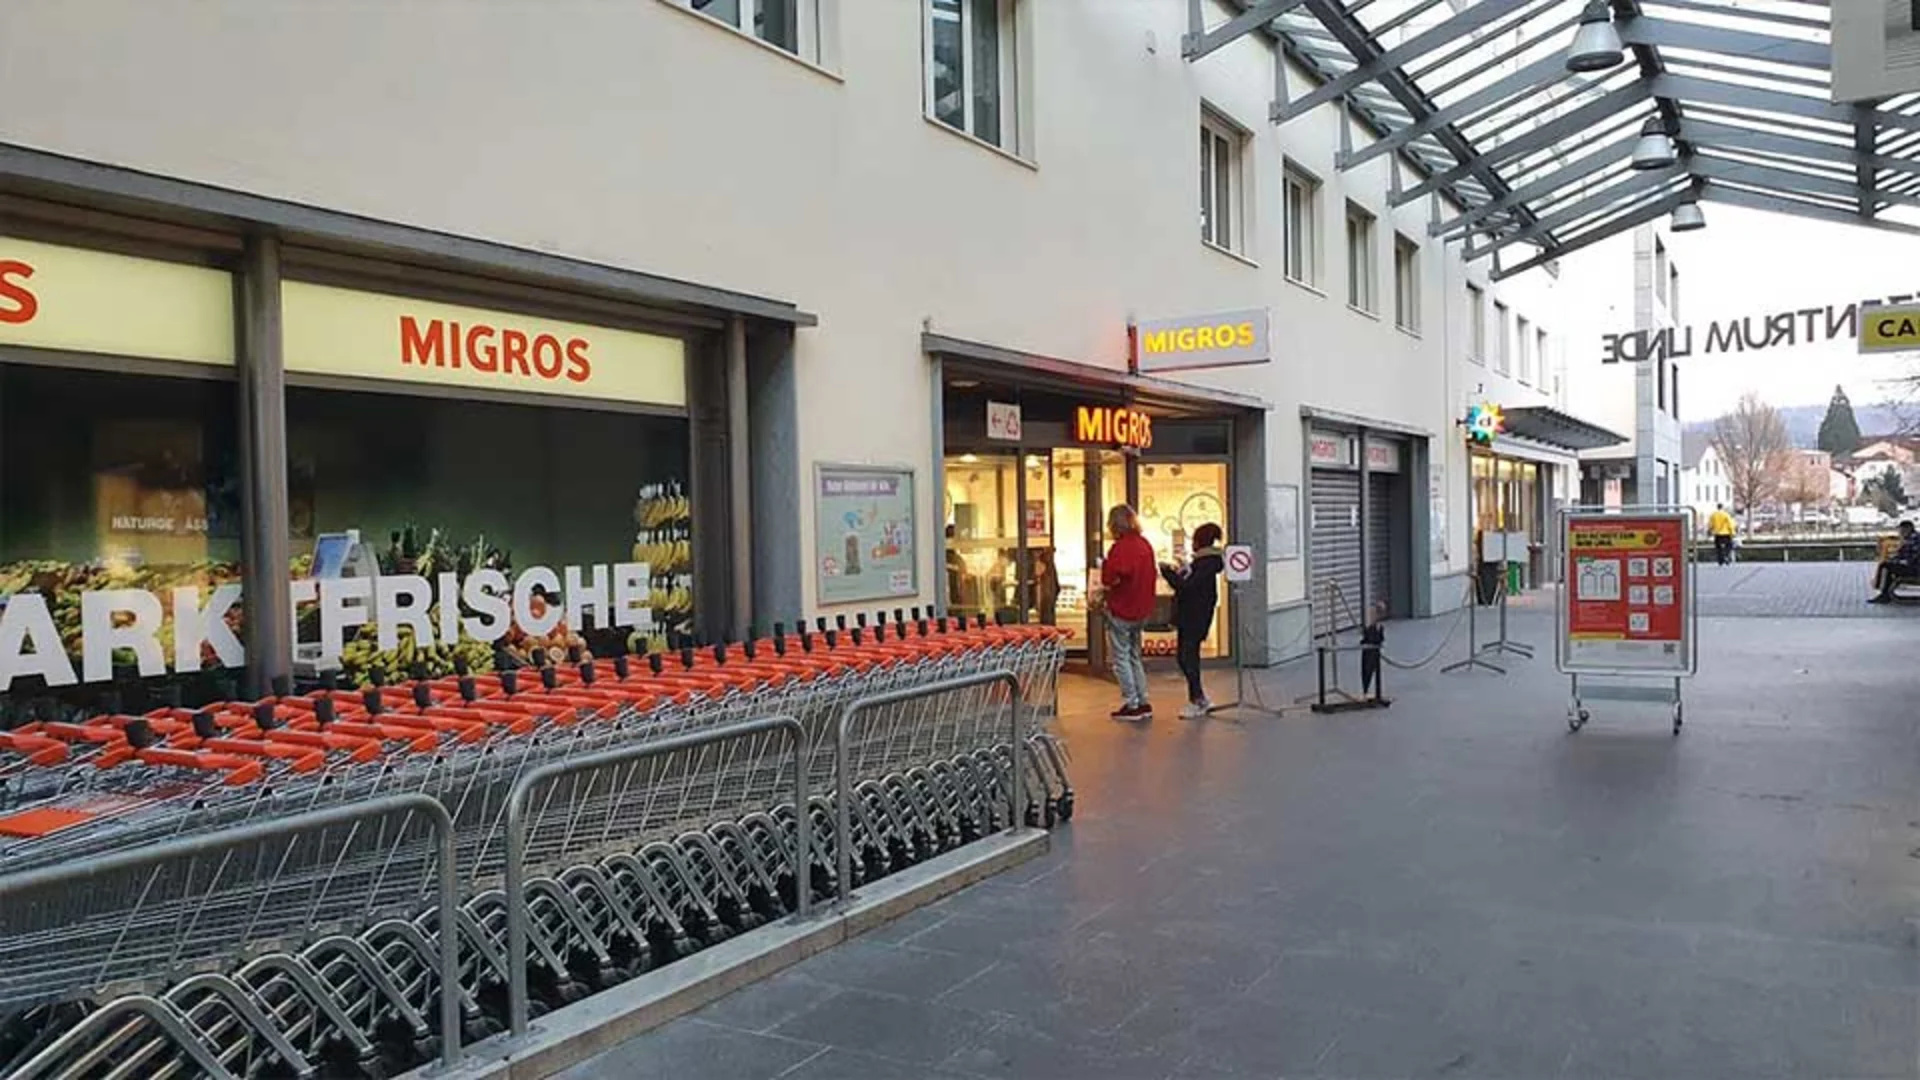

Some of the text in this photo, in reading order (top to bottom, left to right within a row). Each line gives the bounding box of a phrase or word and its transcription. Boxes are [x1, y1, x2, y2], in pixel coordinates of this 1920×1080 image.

[399, 315, 592, 383] MIGROS
[1144, 320, 1255, 354] MIGROS
[1078, 405, 1153, 449] MIGROS
